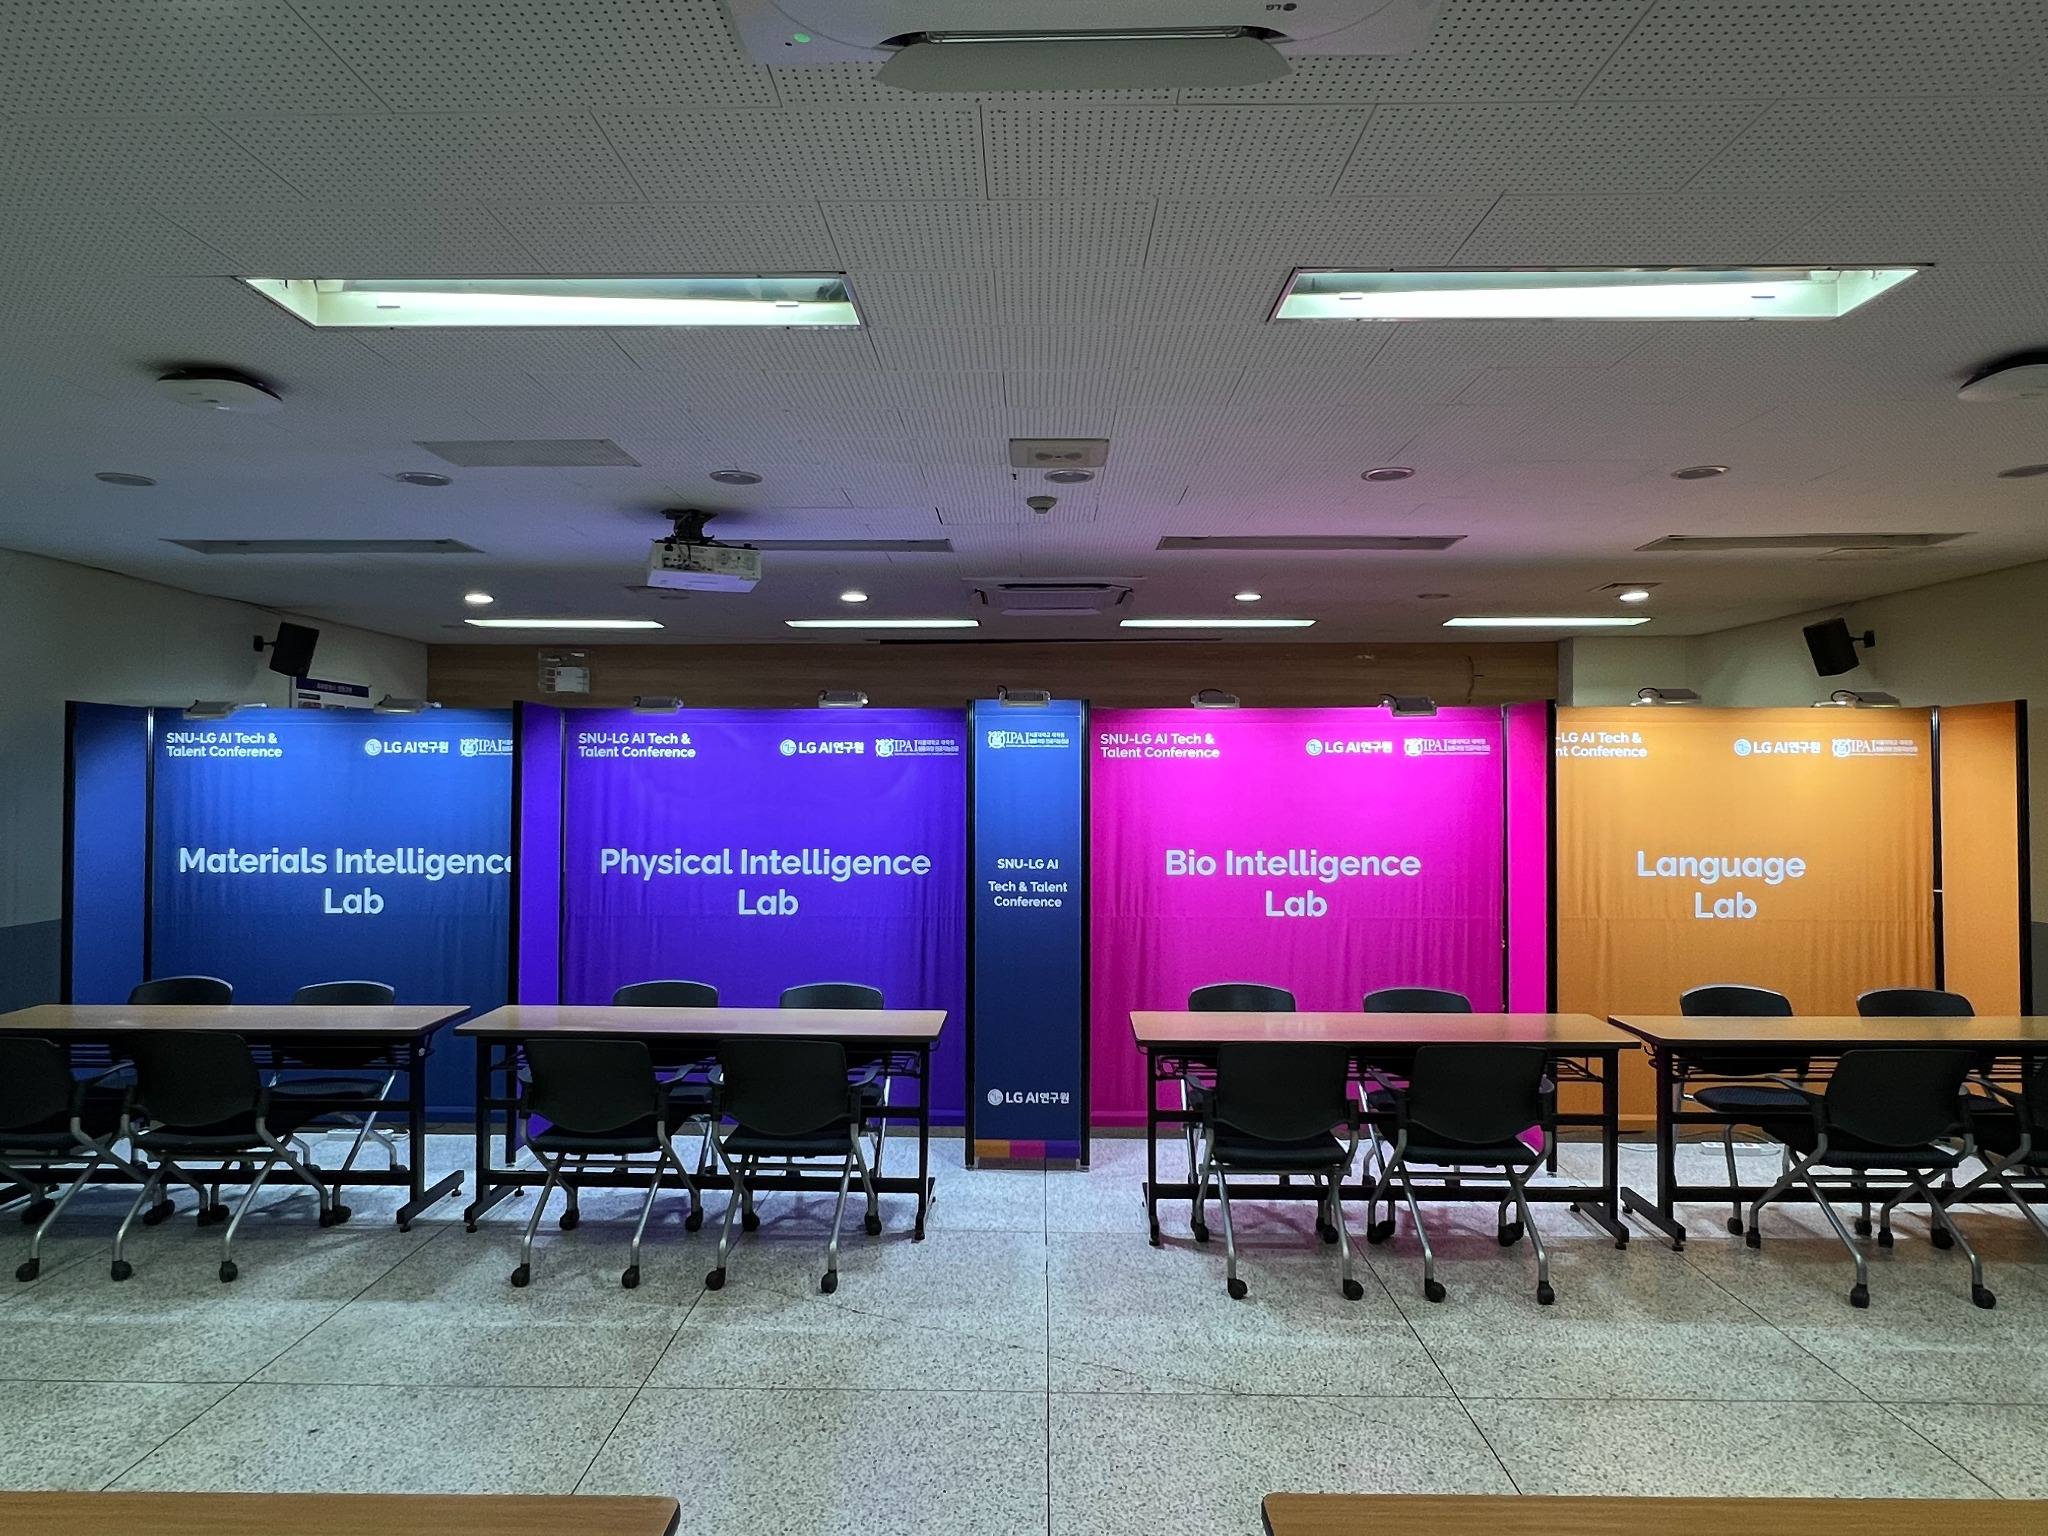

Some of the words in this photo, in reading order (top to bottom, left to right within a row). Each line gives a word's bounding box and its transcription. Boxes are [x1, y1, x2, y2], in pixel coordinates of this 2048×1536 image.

[166, 732, 216, 744] SNU-LG
[218, 732, 232, 744] AI
[235, 732, 264, 744] Tech
[267, 732, 278, 744] &
[578, 732, 630, 744] SNU-LG
[632, 732, 645, 744] AI
[648, 732, 678, 744] Tech
[680, 732, 691, 744] &
[1100, 732, 1152, 744] SNU-LG
[1154, 732, 1168, 744] AI
[1171, 732, 1201, 744] Tech
[1204, 732, 1215, 744] &
[1581, 732, 1595, 743] AI
[1597, 732, 1629, 743] Tech
[1631, 732, 1642, 743] &
[167, 745, 206, 758] Talent
[208, 745, 283, 758] Conference
[384, 740, 404, 754] LG
[579, 746, 619, 758] Talent
[621, 746, 696, 758] Conference
[799, 740, 818, 754] LG
[1100, 746, 1141, 759] Talent
[1143, 746, 1220, 759] Conference
[1325, 740, 1344, 754] LG
[1571, 745, 1648, 758] Conference
[1753, 740, 1772, 754] LG
[179, 847, 327, 874] Materials
[601, 847, 732, 880] Physical
[741, 847, 931, 881] Intelligence
[997, 858, 1044, 870] SNU-LG
[1047, 858, 1059, 870] AI
[1166, 849, 1217, 876] Bio
[1226, 849, 1421, 883] Intelligence
[1637, 850, 1807, 885] Language
[988, 880, 1016, 893] Tech
[1019, 880, 1028, 893] &
[1030, 880, 1068, 893] Talent
[324, 888, 384, 914] Lab
[738, 888, 799, 915] Lab
[994, 896, 1062, 908] Conference
[1265, 890, 1328, 917] Lab
[1695, 891, 1758, 919] Lab
[1006, 1091, 1023, 1104] LG
